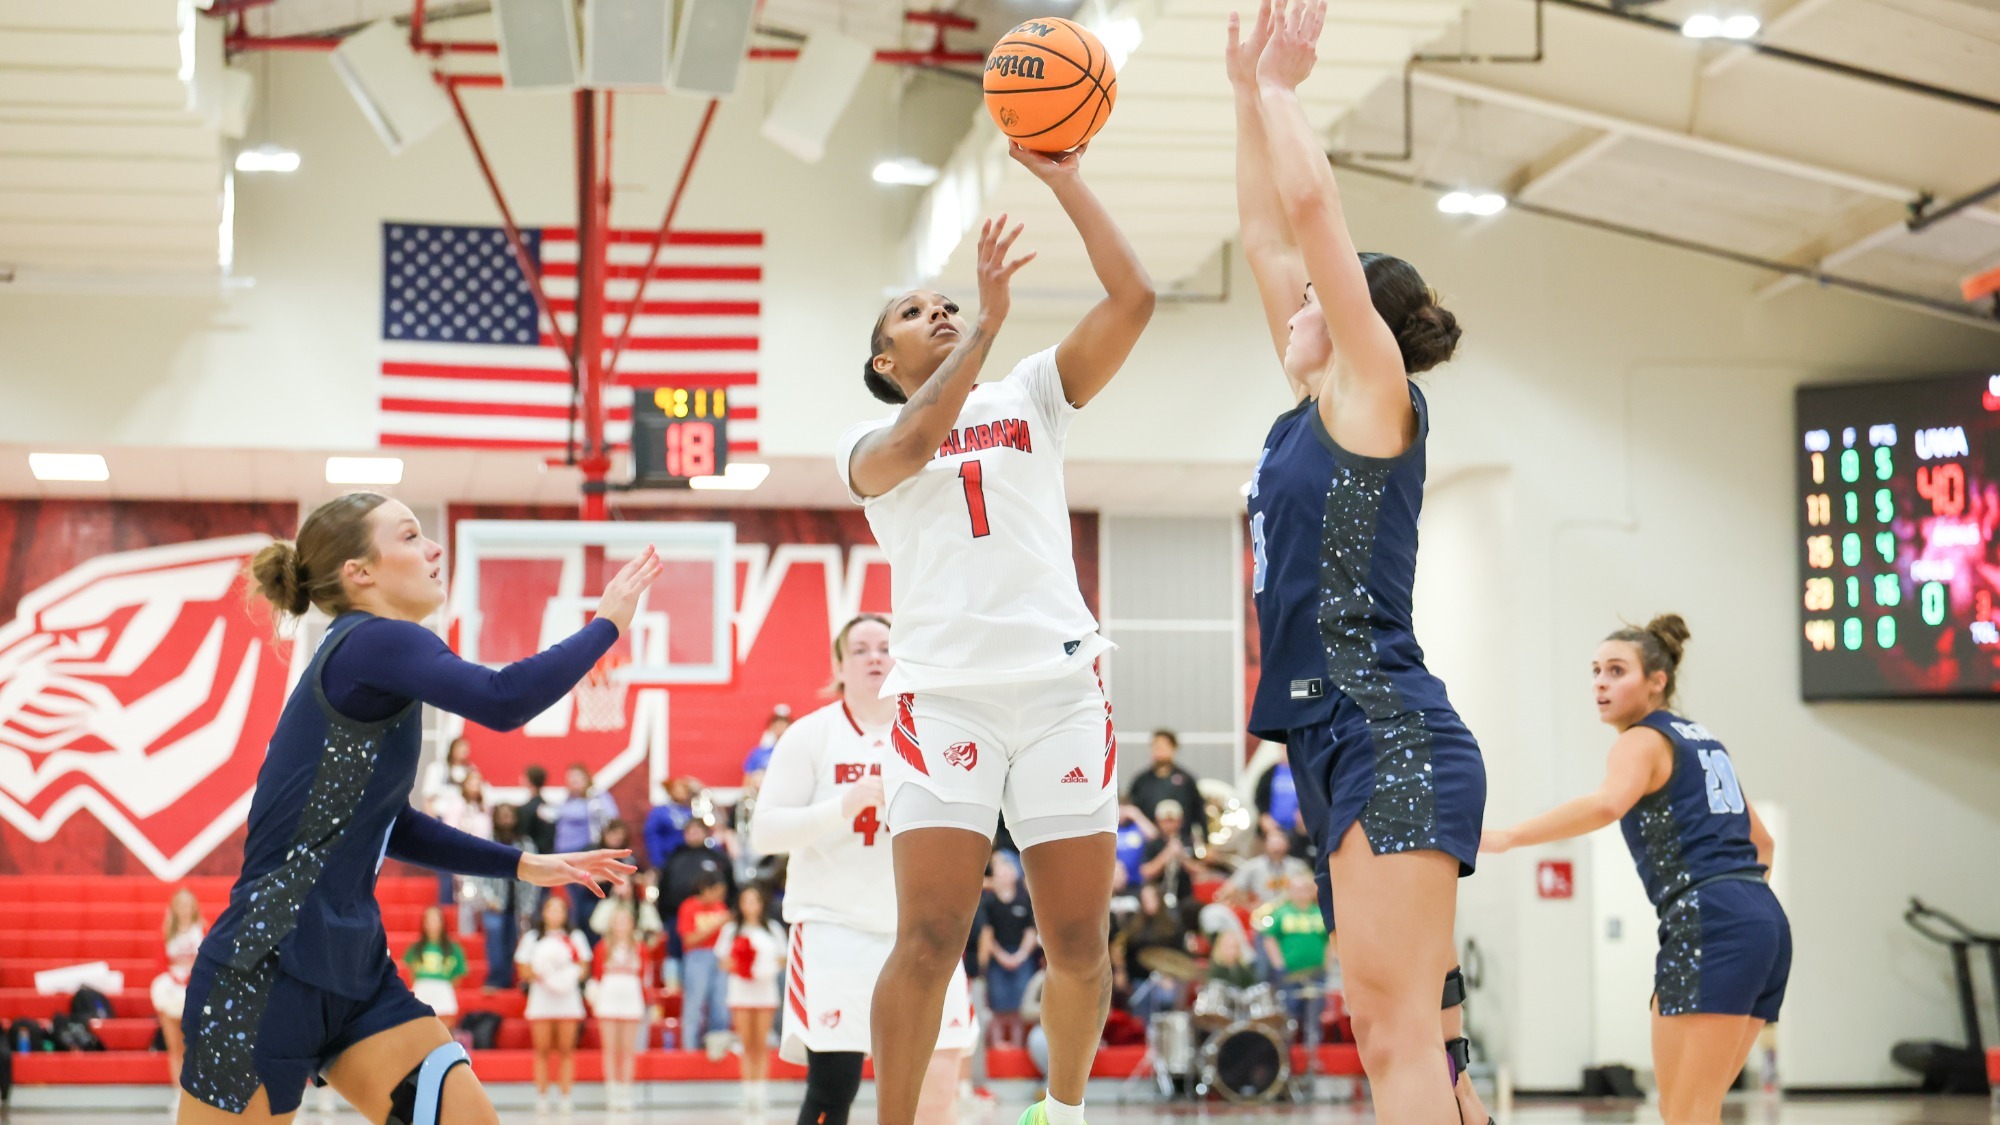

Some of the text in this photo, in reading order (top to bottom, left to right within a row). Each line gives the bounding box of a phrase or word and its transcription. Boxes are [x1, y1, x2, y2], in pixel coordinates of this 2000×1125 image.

[666, 421, 715, 477] 18
[1811, 452, 1825, 484] 1
[1874, 446, 1893, 480] 5
[958, 459, 990, 538] 1
[1806, 488, 1894, 526] 11 1 5
[1917, 462, 1965, 516] 40
[1846, 575, 1859, 608] 1
[1921, 581, 1945, 626] 0
[1060, 776, 1089, 784] adidas
[1697, 748, 1745, 814] 20
[853, 805, 891, 847] 4
